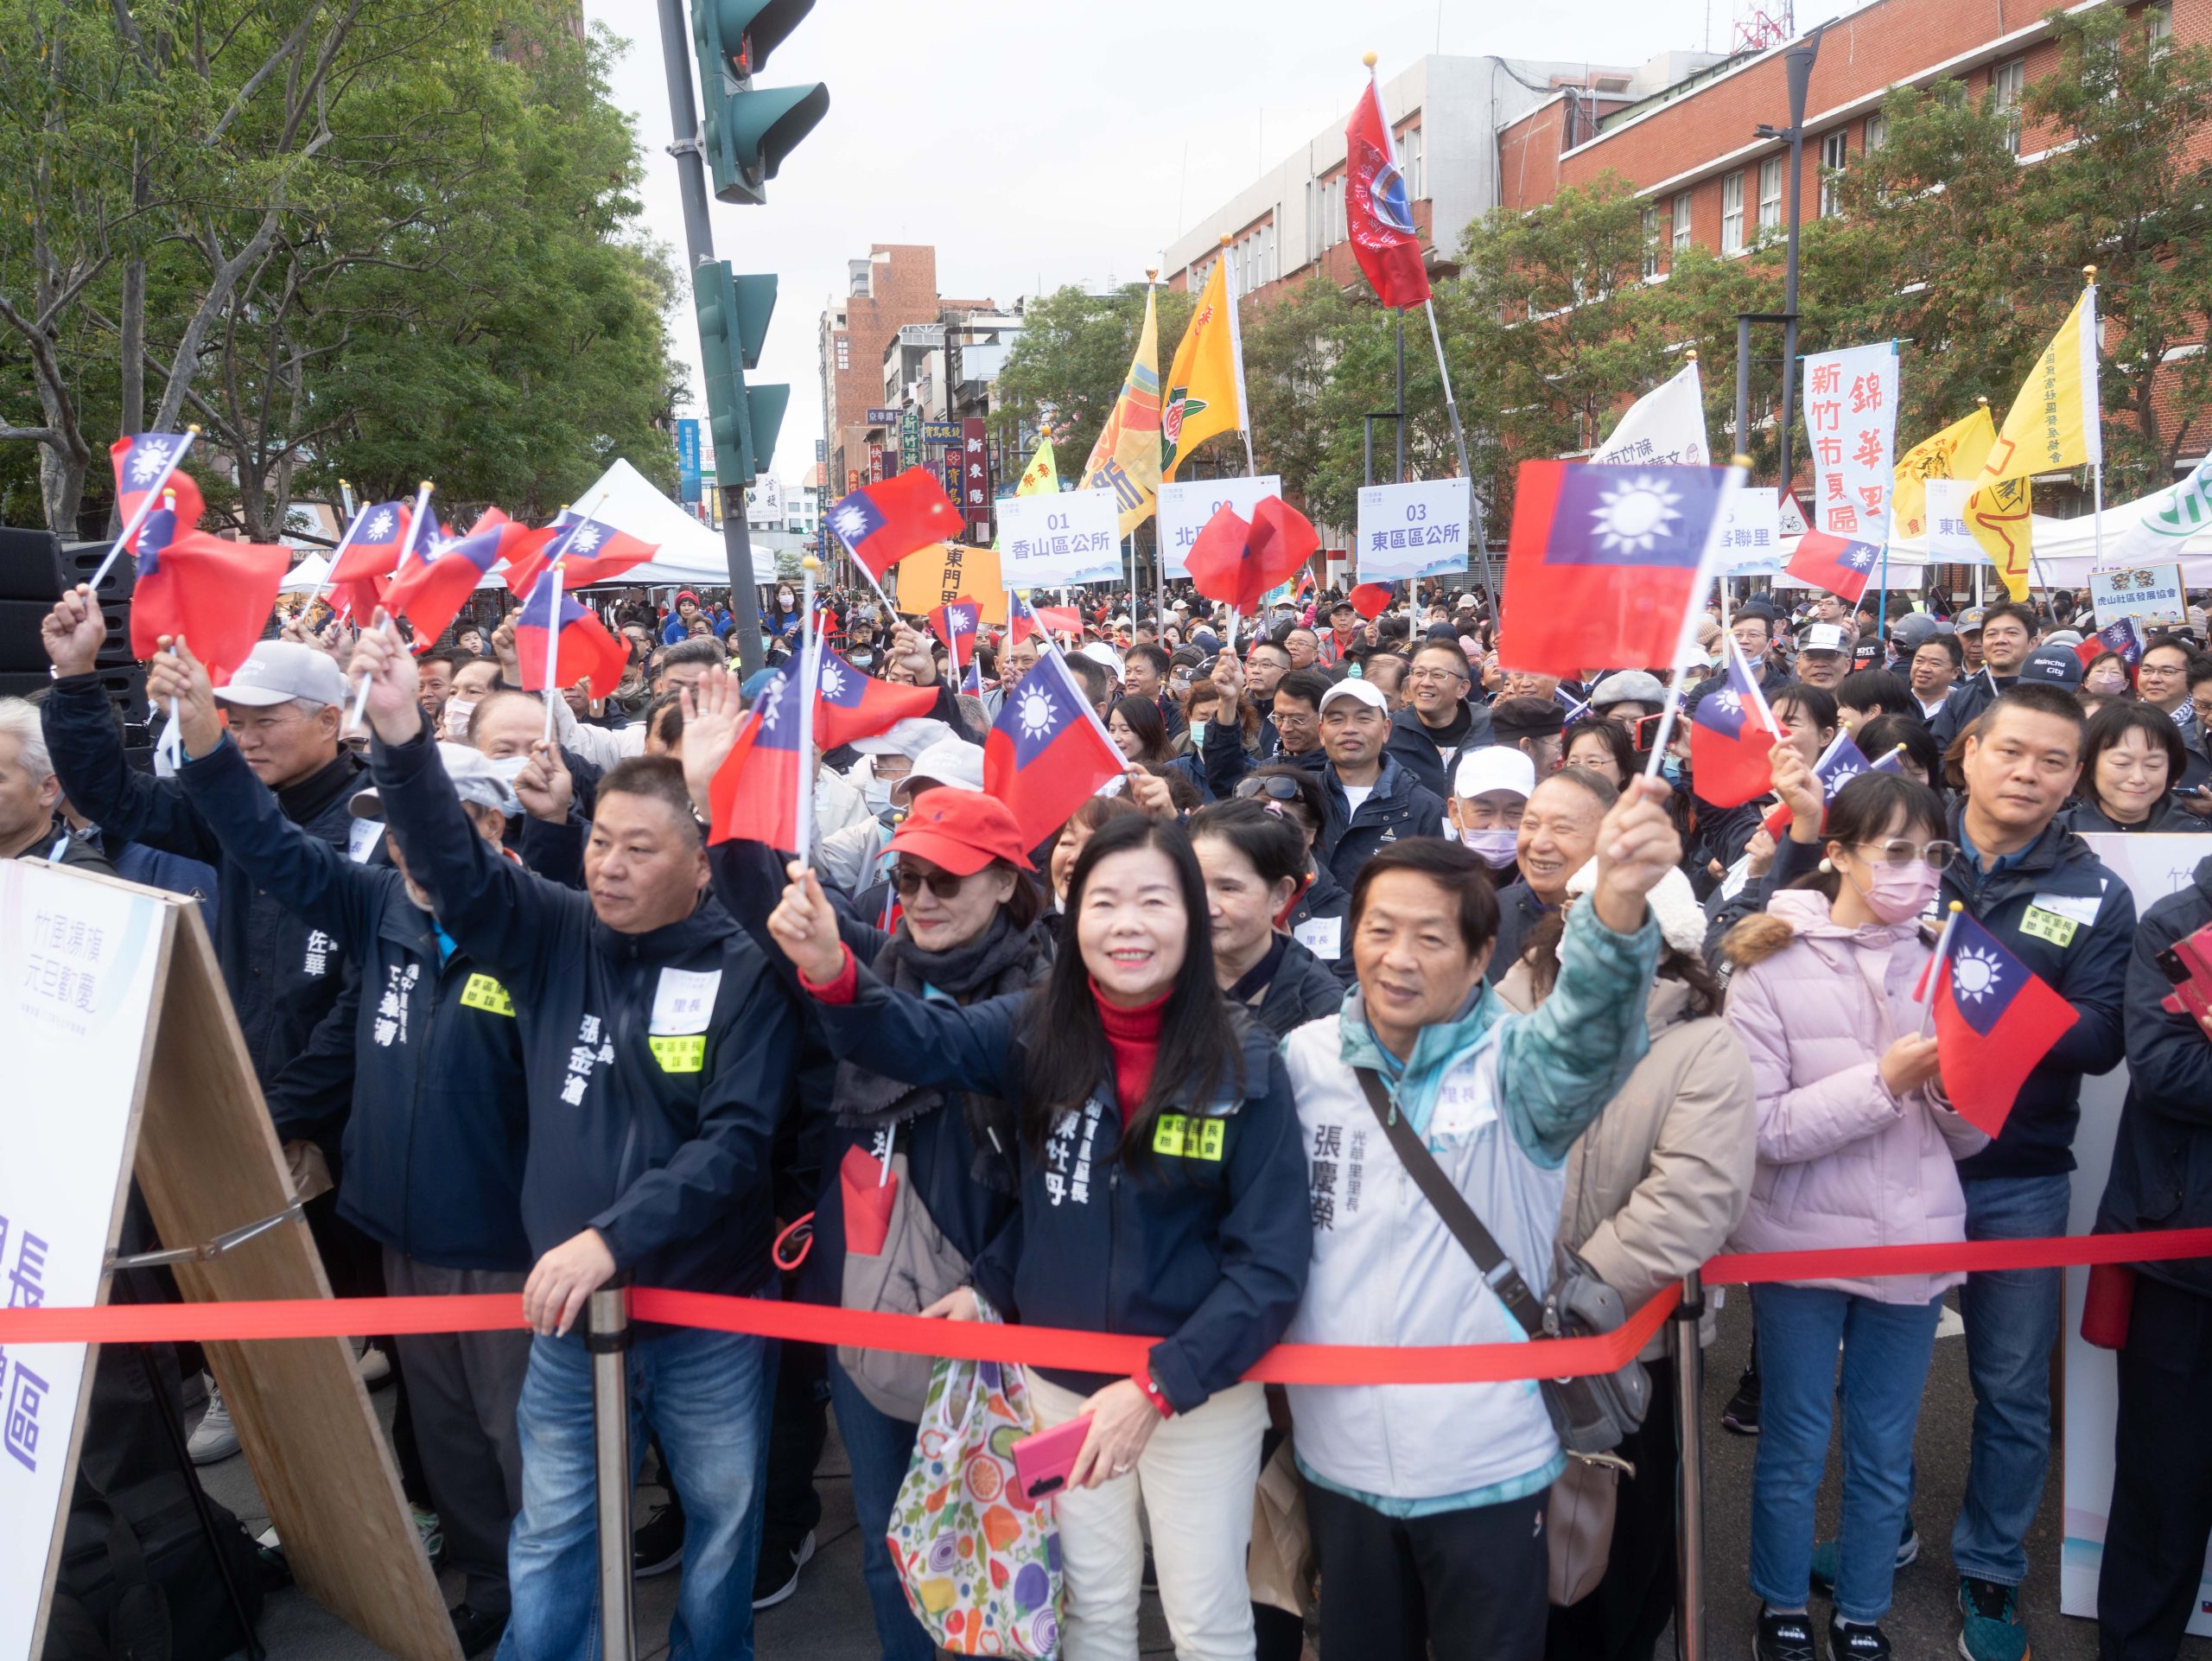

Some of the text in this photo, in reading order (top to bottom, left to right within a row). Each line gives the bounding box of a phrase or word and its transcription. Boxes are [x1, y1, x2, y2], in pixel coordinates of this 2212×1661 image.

[925, 425, 962, 439] 寶島眼鏡
[1811, 362, 1858, 534] 新竹市東區
[1848, 372, 1885, 518] 錦華里
[967, 438, 984, 504] 新東陽
[1047, 512, 1070, 531] 01
[1407, 504, 1427, 522] 03
[1012, 531, 1110, 560] 香山區公所
[1372, 524, 1460, 551] 東區區公所
[941, 548, 964, 605] 東門里
[2097, 588, 2176, 606] 虎山社區發展協會
[2033, 658, 2066, 667] Hsinchu
[2046, 666, 2064, 677] City
[1306, 935, 1327, 945] 里長
[672, 999, 701, 1013] 里長
[1311, 1124, 1343, 1231] 張慶榮
